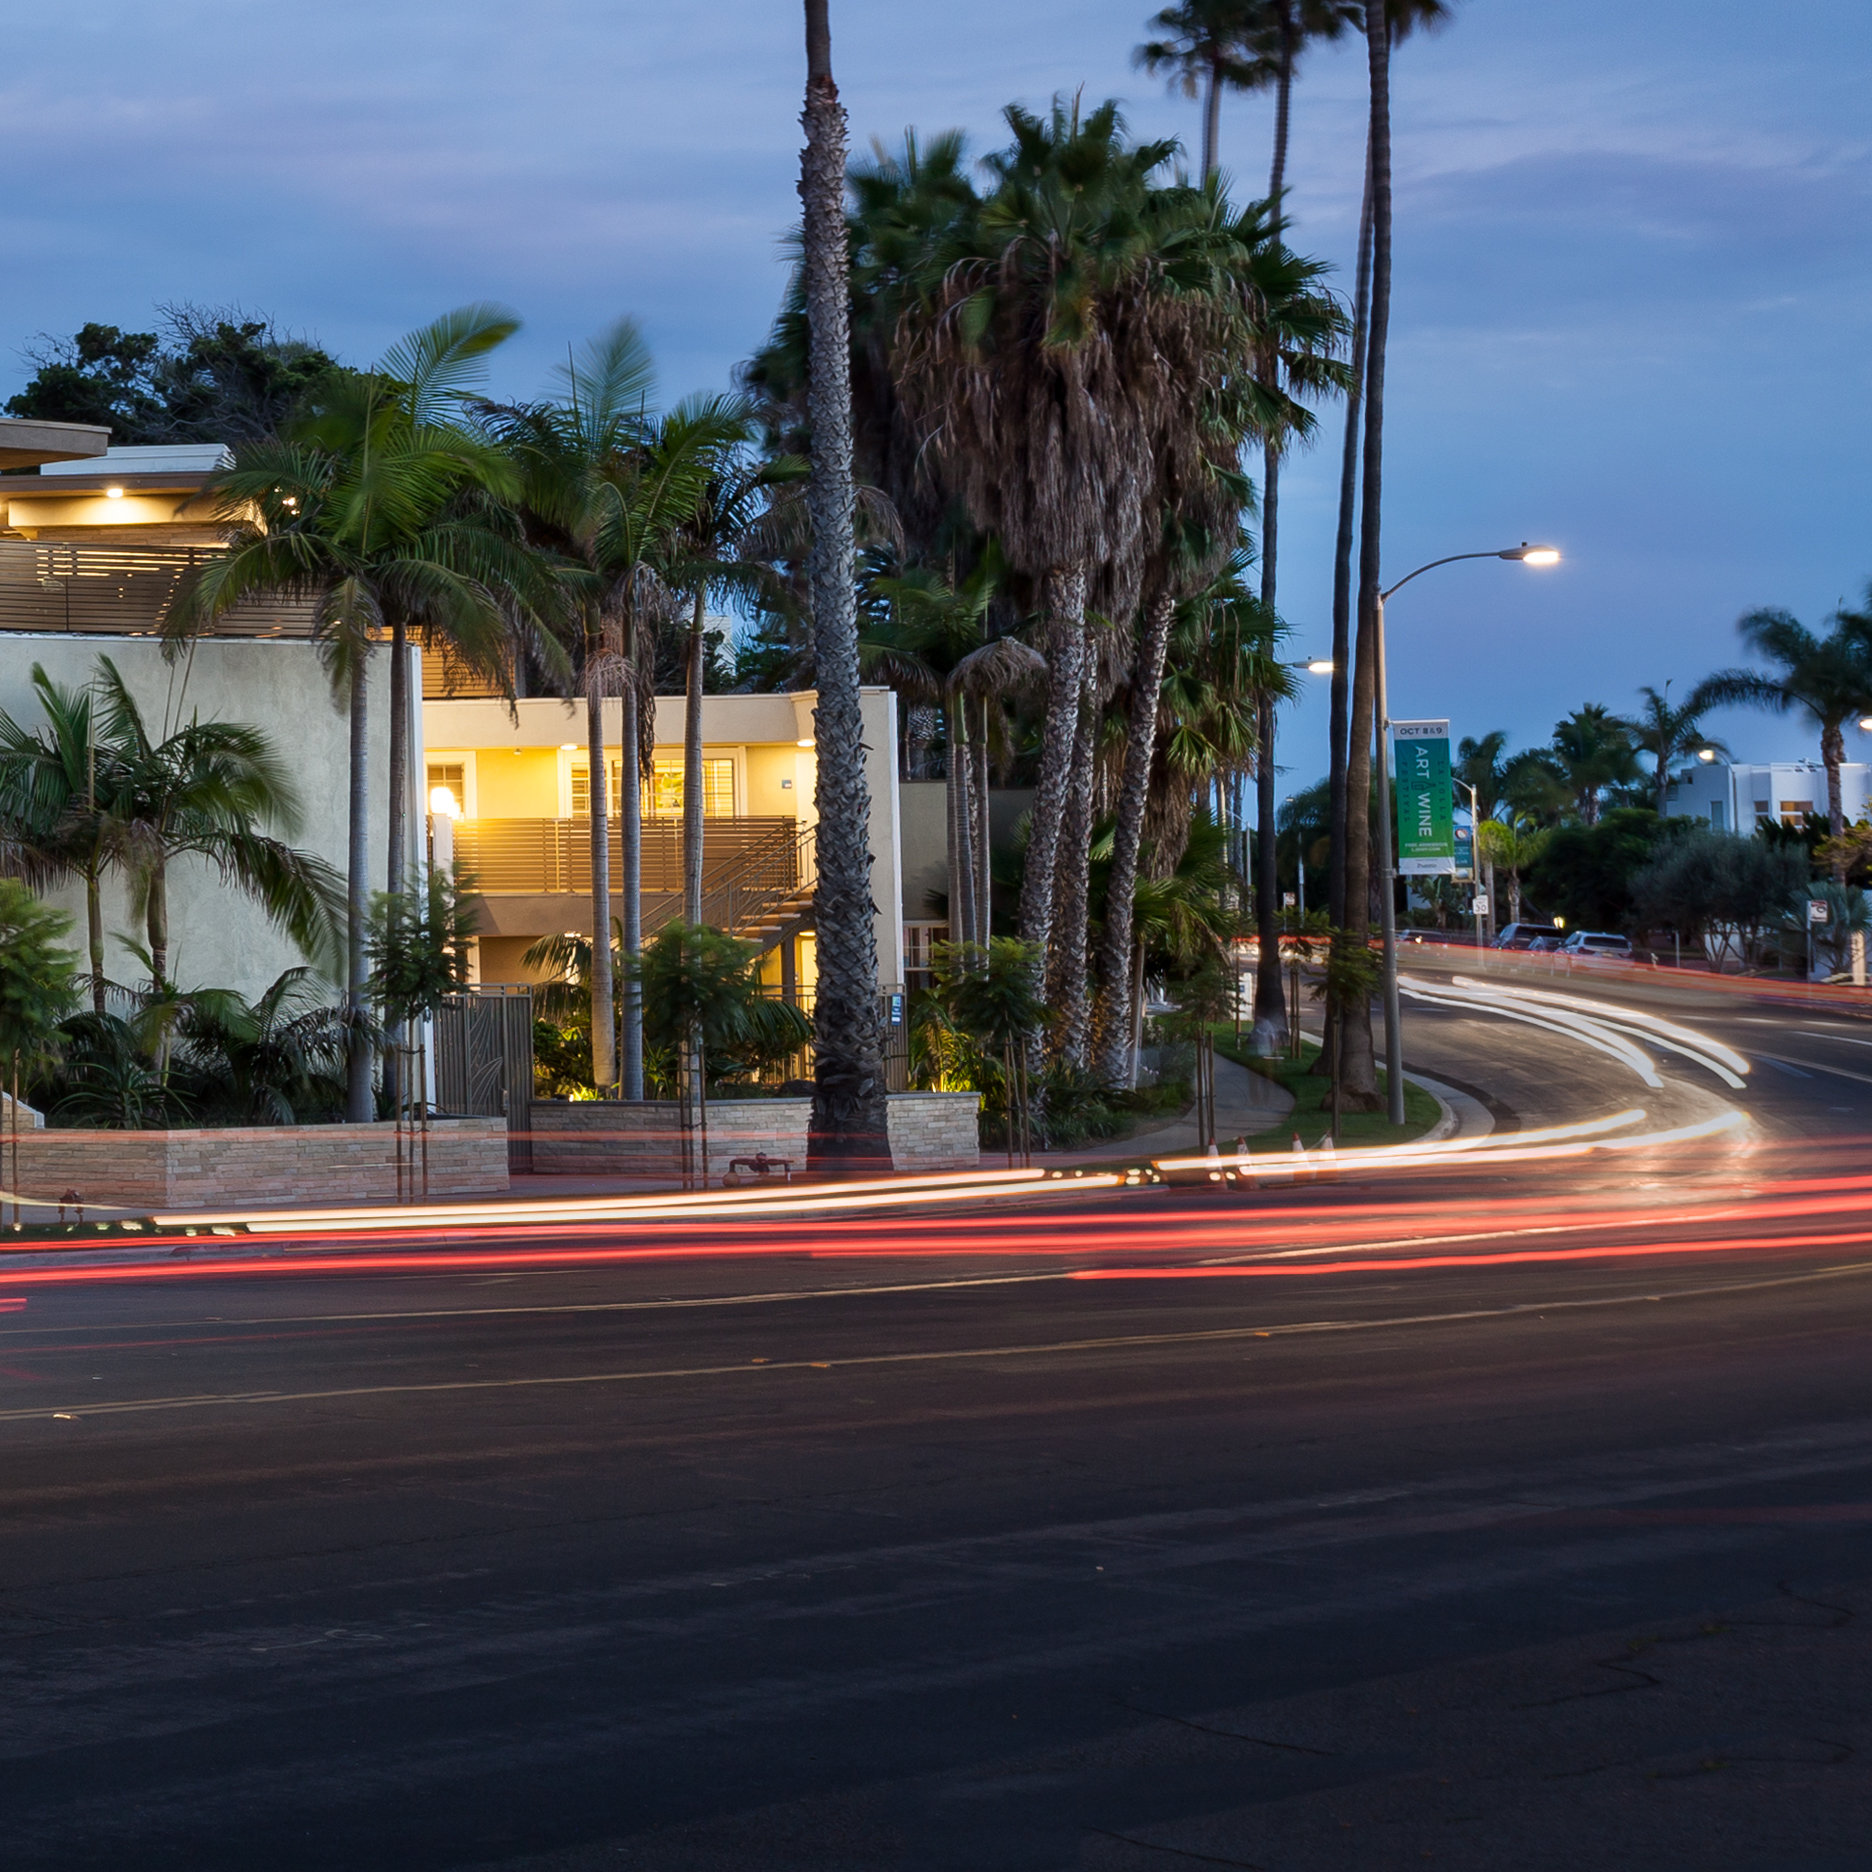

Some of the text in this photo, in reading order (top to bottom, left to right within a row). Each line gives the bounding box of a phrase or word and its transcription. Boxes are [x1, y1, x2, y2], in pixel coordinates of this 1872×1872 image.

[1400, 727, 1420, 735] OCT
[1416, 746, 1430, 779] ART
[1418, 792, 1432, 836] WINE
